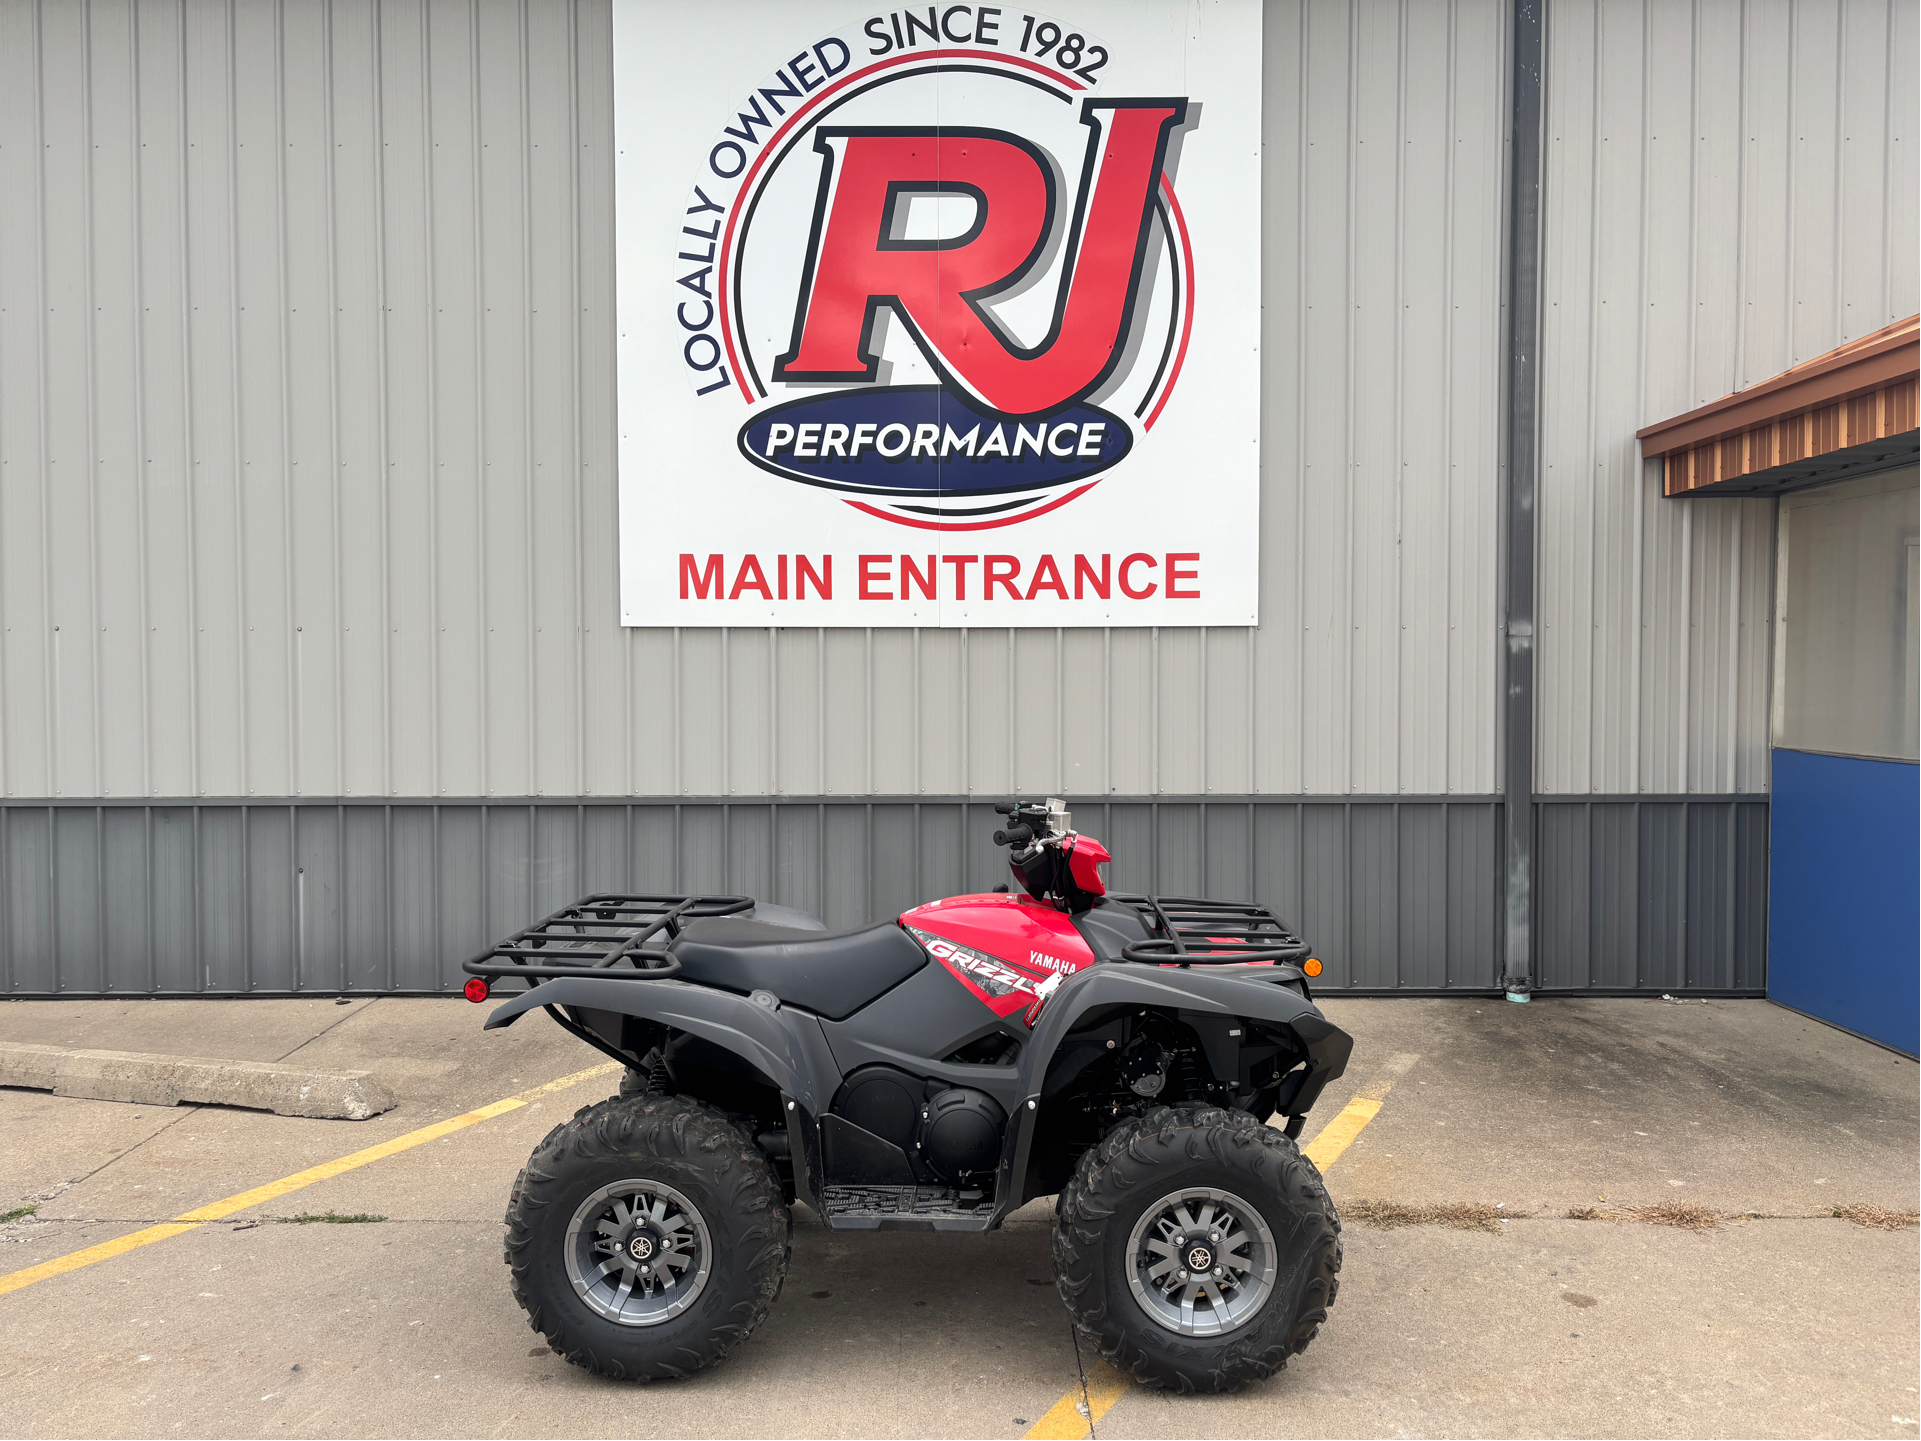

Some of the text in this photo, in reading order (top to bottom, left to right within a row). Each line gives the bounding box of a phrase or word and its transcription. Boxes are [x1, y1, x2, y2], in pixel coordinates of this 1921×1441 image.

[675, 5, 1109, 397] LOCALLY OWNED SINCE 1982
[771, 96, 1189, 423] RJ
[765, 421, 1107, 458] PERFORMANCE
[679, 552, 1201, 601] MAIN ENTRANCE
[925, 938, 1040, 996] GRIZZL
[1029, 949, 1077, 975] YAMAHA
